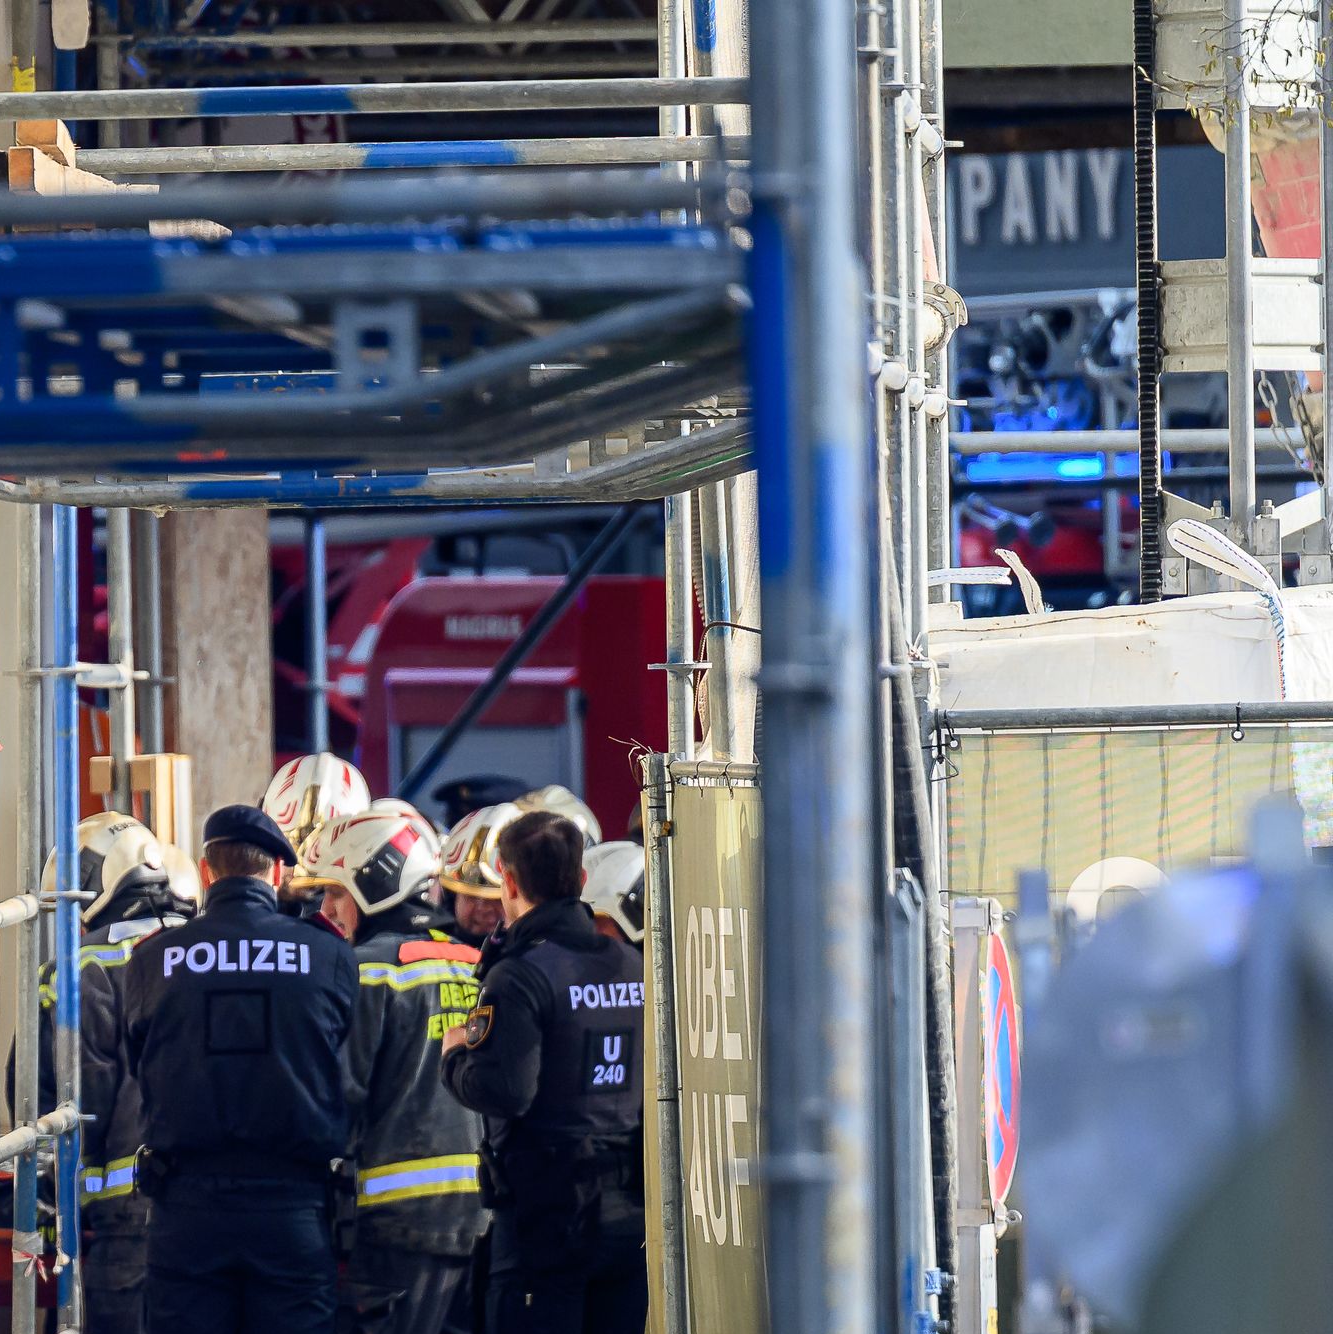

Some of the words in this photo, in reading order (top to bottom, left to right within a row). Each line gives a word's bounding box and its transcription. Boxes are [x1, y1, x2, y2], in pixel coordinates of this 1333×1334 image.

[959, 149, 1120, 245] PANY
[163, 939, 311, 978] POLIZEI
[603, 1035, 622, 1062] U
[593, 1064, 625, 1085] 240
[689, 1091, 750, 1246] AUF
